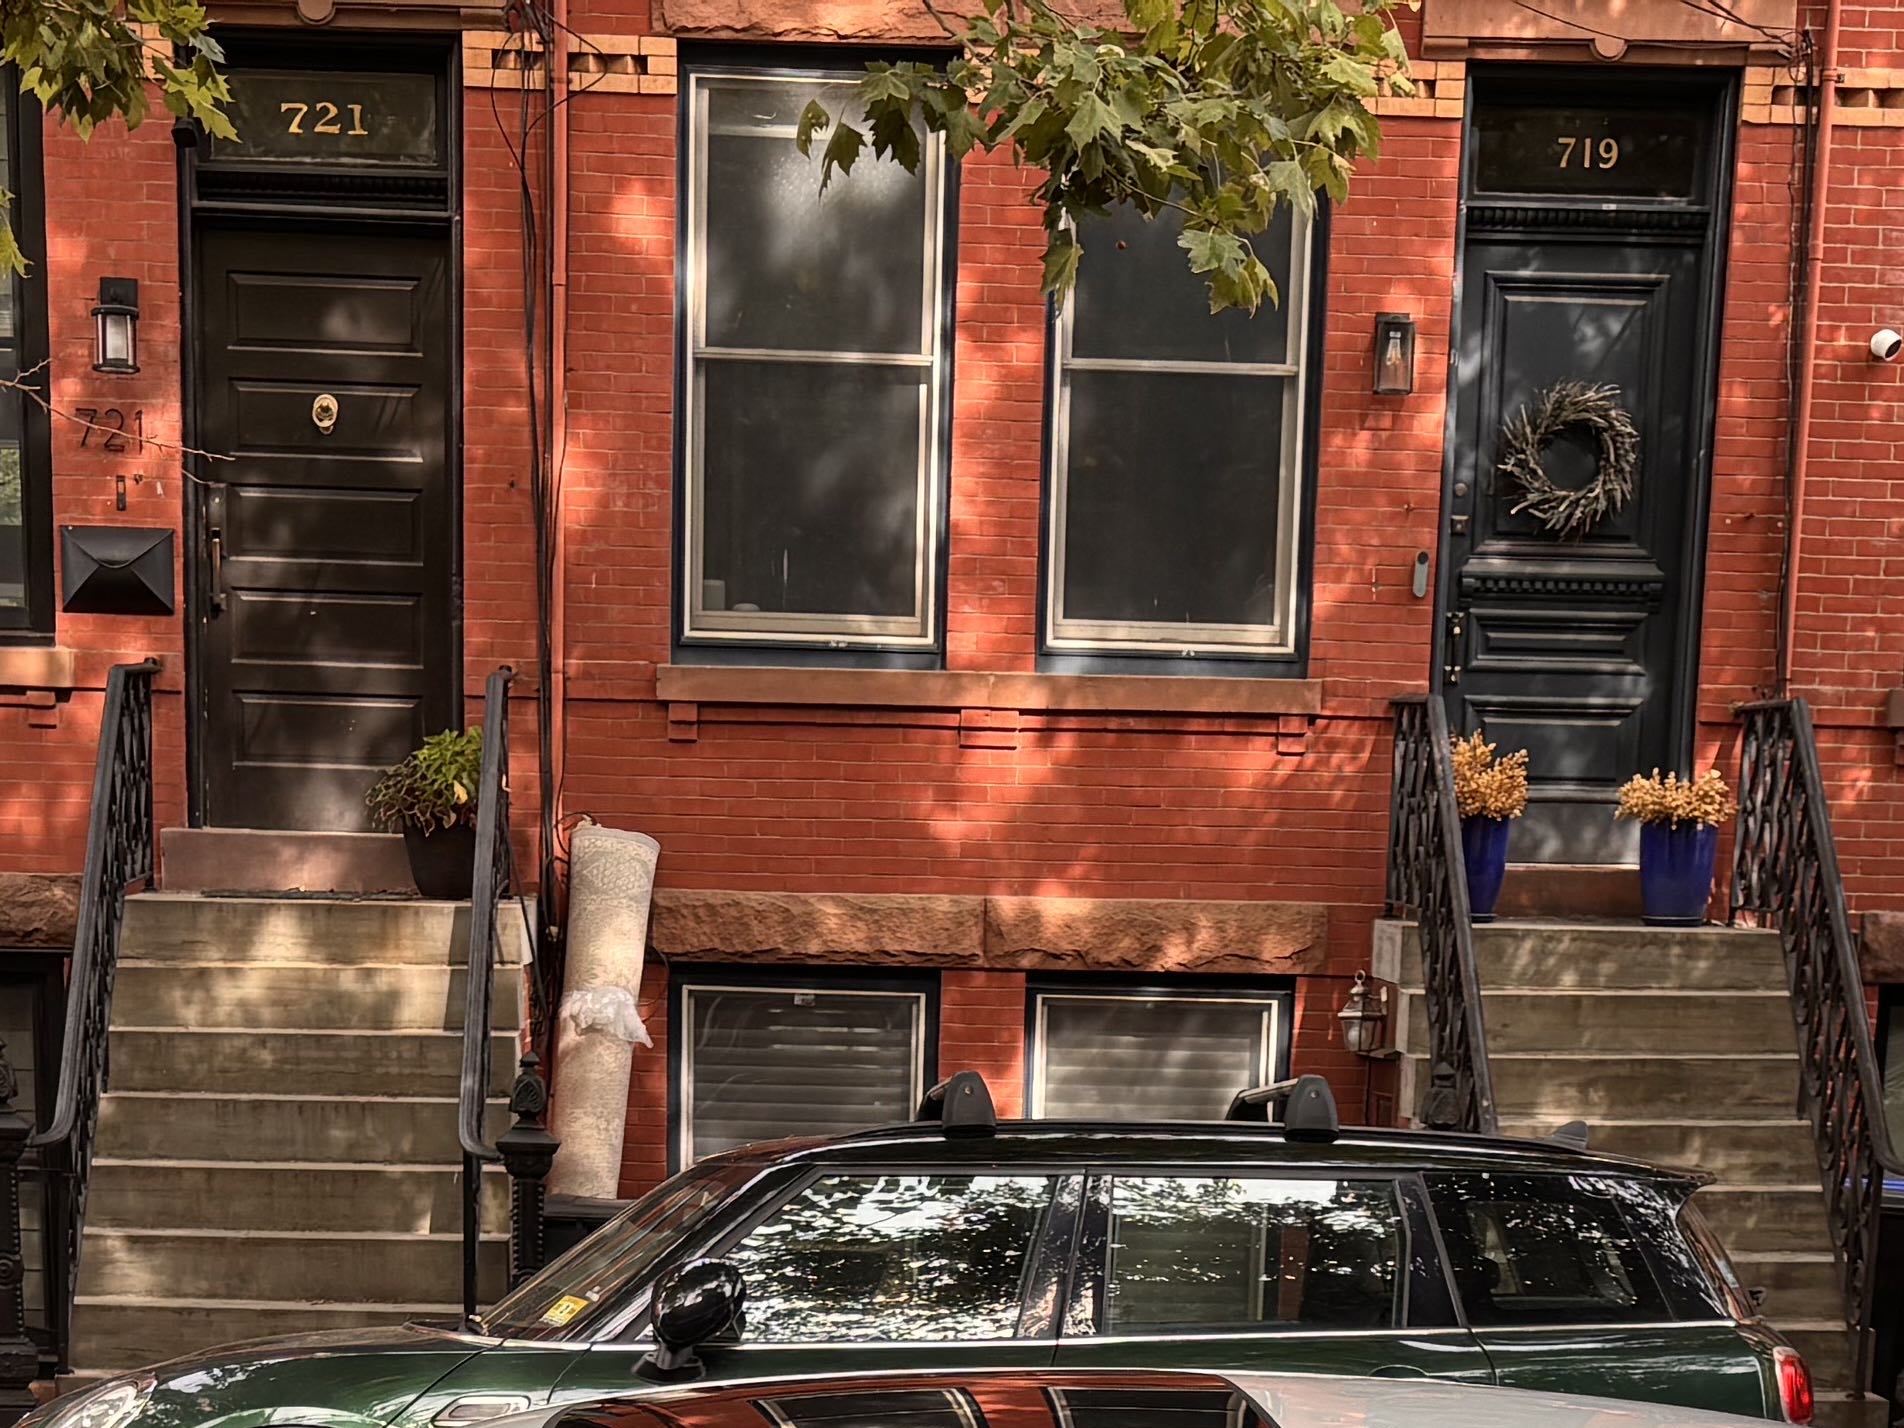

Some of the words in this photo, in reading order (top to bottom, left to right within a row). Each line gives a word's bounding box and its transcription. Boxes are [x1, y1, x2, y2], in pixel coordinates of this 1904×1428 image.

[281, 102, 369, 135] 721
[1558, 137, 1619, 169] 719
[75, 408, 144, 455] 721
